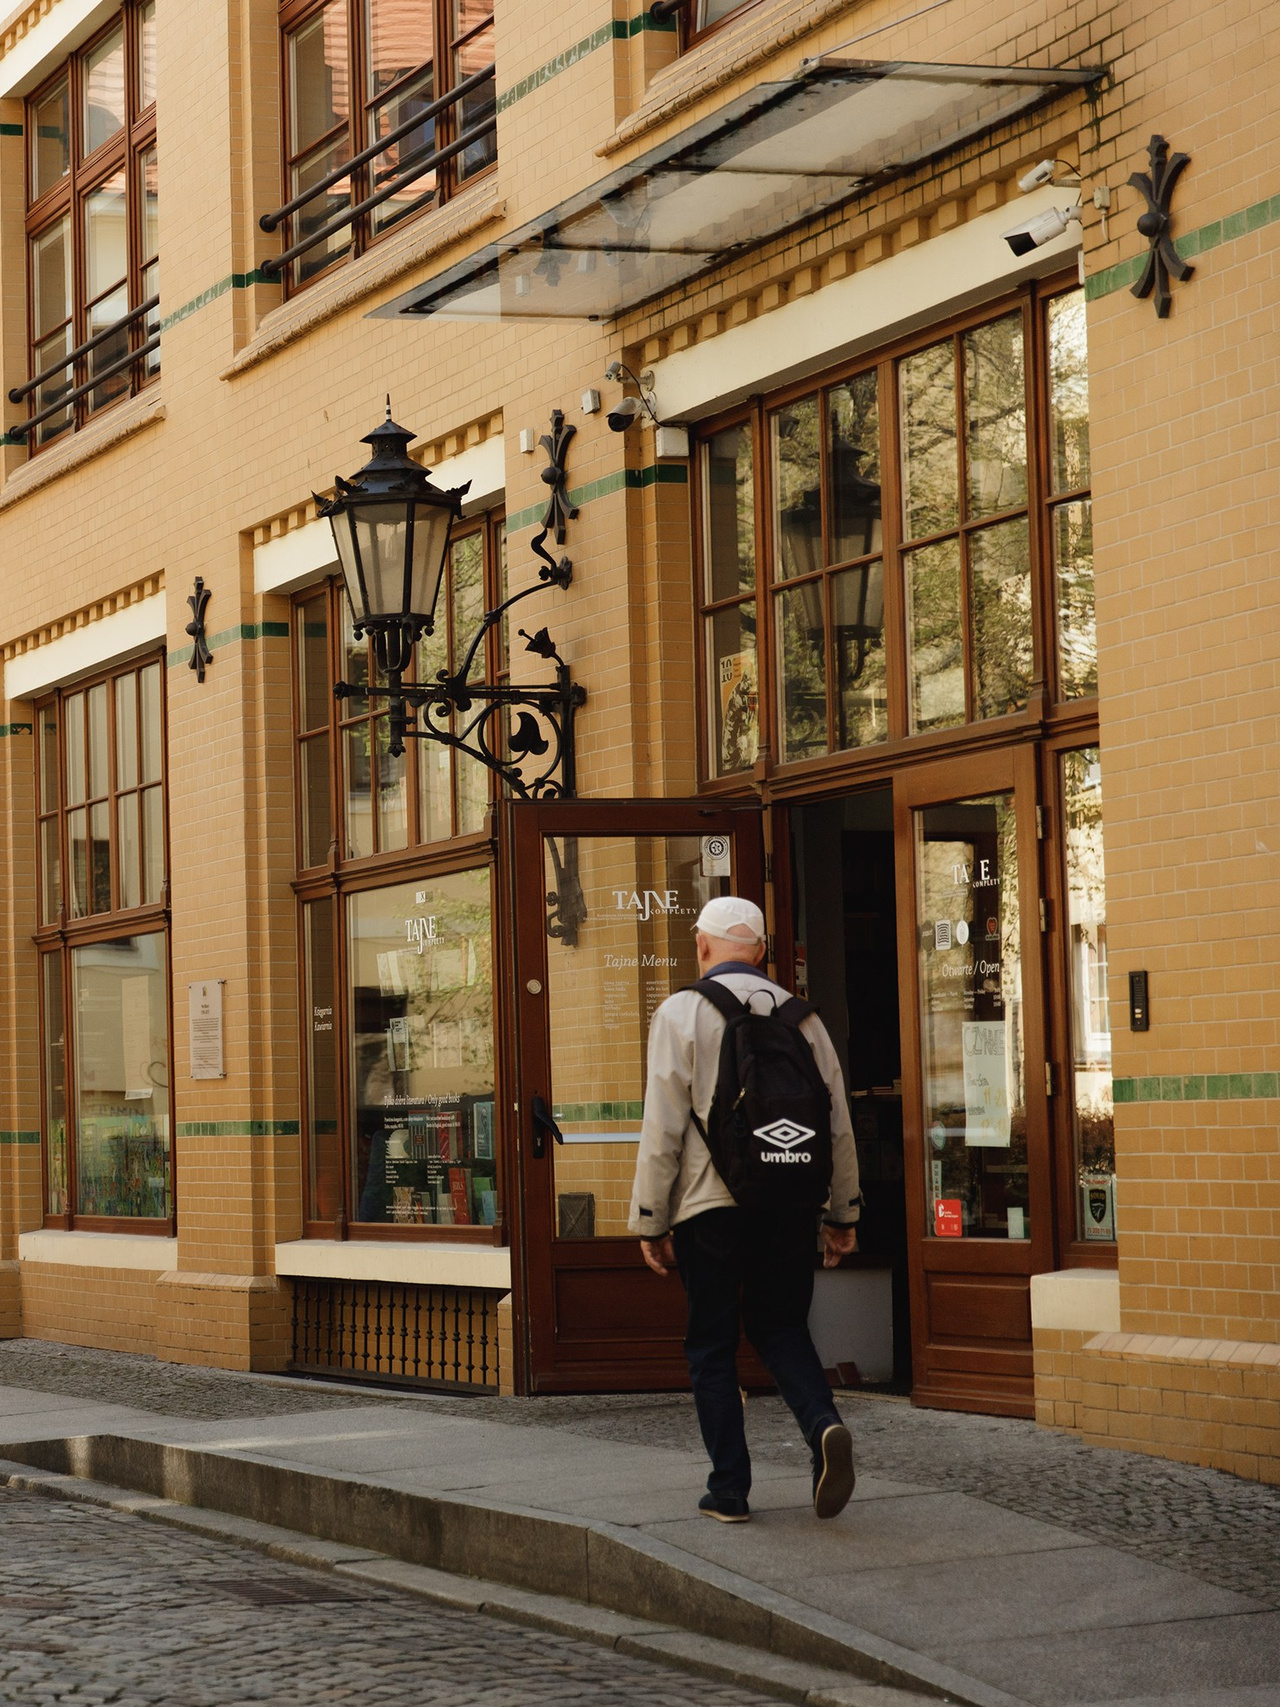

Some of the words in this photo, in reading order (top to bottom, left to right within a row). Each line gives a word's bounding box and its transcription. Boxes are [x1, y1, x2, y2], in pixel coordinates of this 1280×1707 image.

[612, 890, 679, 921] TAJNE
[405, 916, 437, 954] TAJNE
[603, 954, 638, 970] Tajne
[641, 954, 678, 967] Menu
[942, 964, 973, 977] Otwarte
[980, 960, 1000, 977] Open
[761, 1149, 811, 1163] umbro
